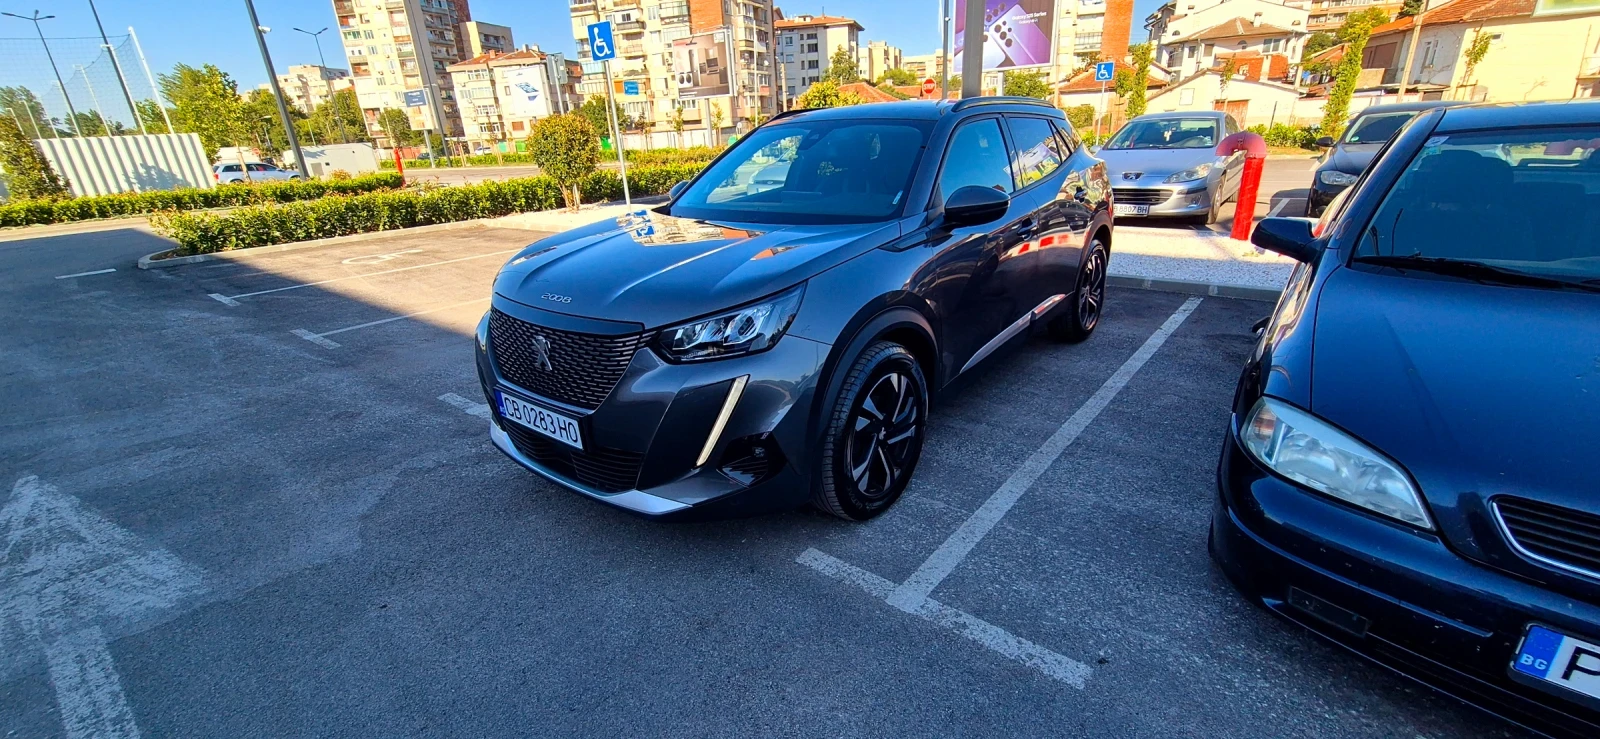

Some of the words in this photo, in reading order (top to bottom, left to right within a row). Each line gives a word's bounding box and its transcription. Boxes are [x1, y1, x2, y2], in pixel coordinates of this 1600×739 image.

[541, 292, 572, 304] 2008
[504, 397, 522, 420] CB
[523, 404, 556, 434] 0283
[556, 416, 578, 443] HO
[1519, 653, 1548, 670] BG
